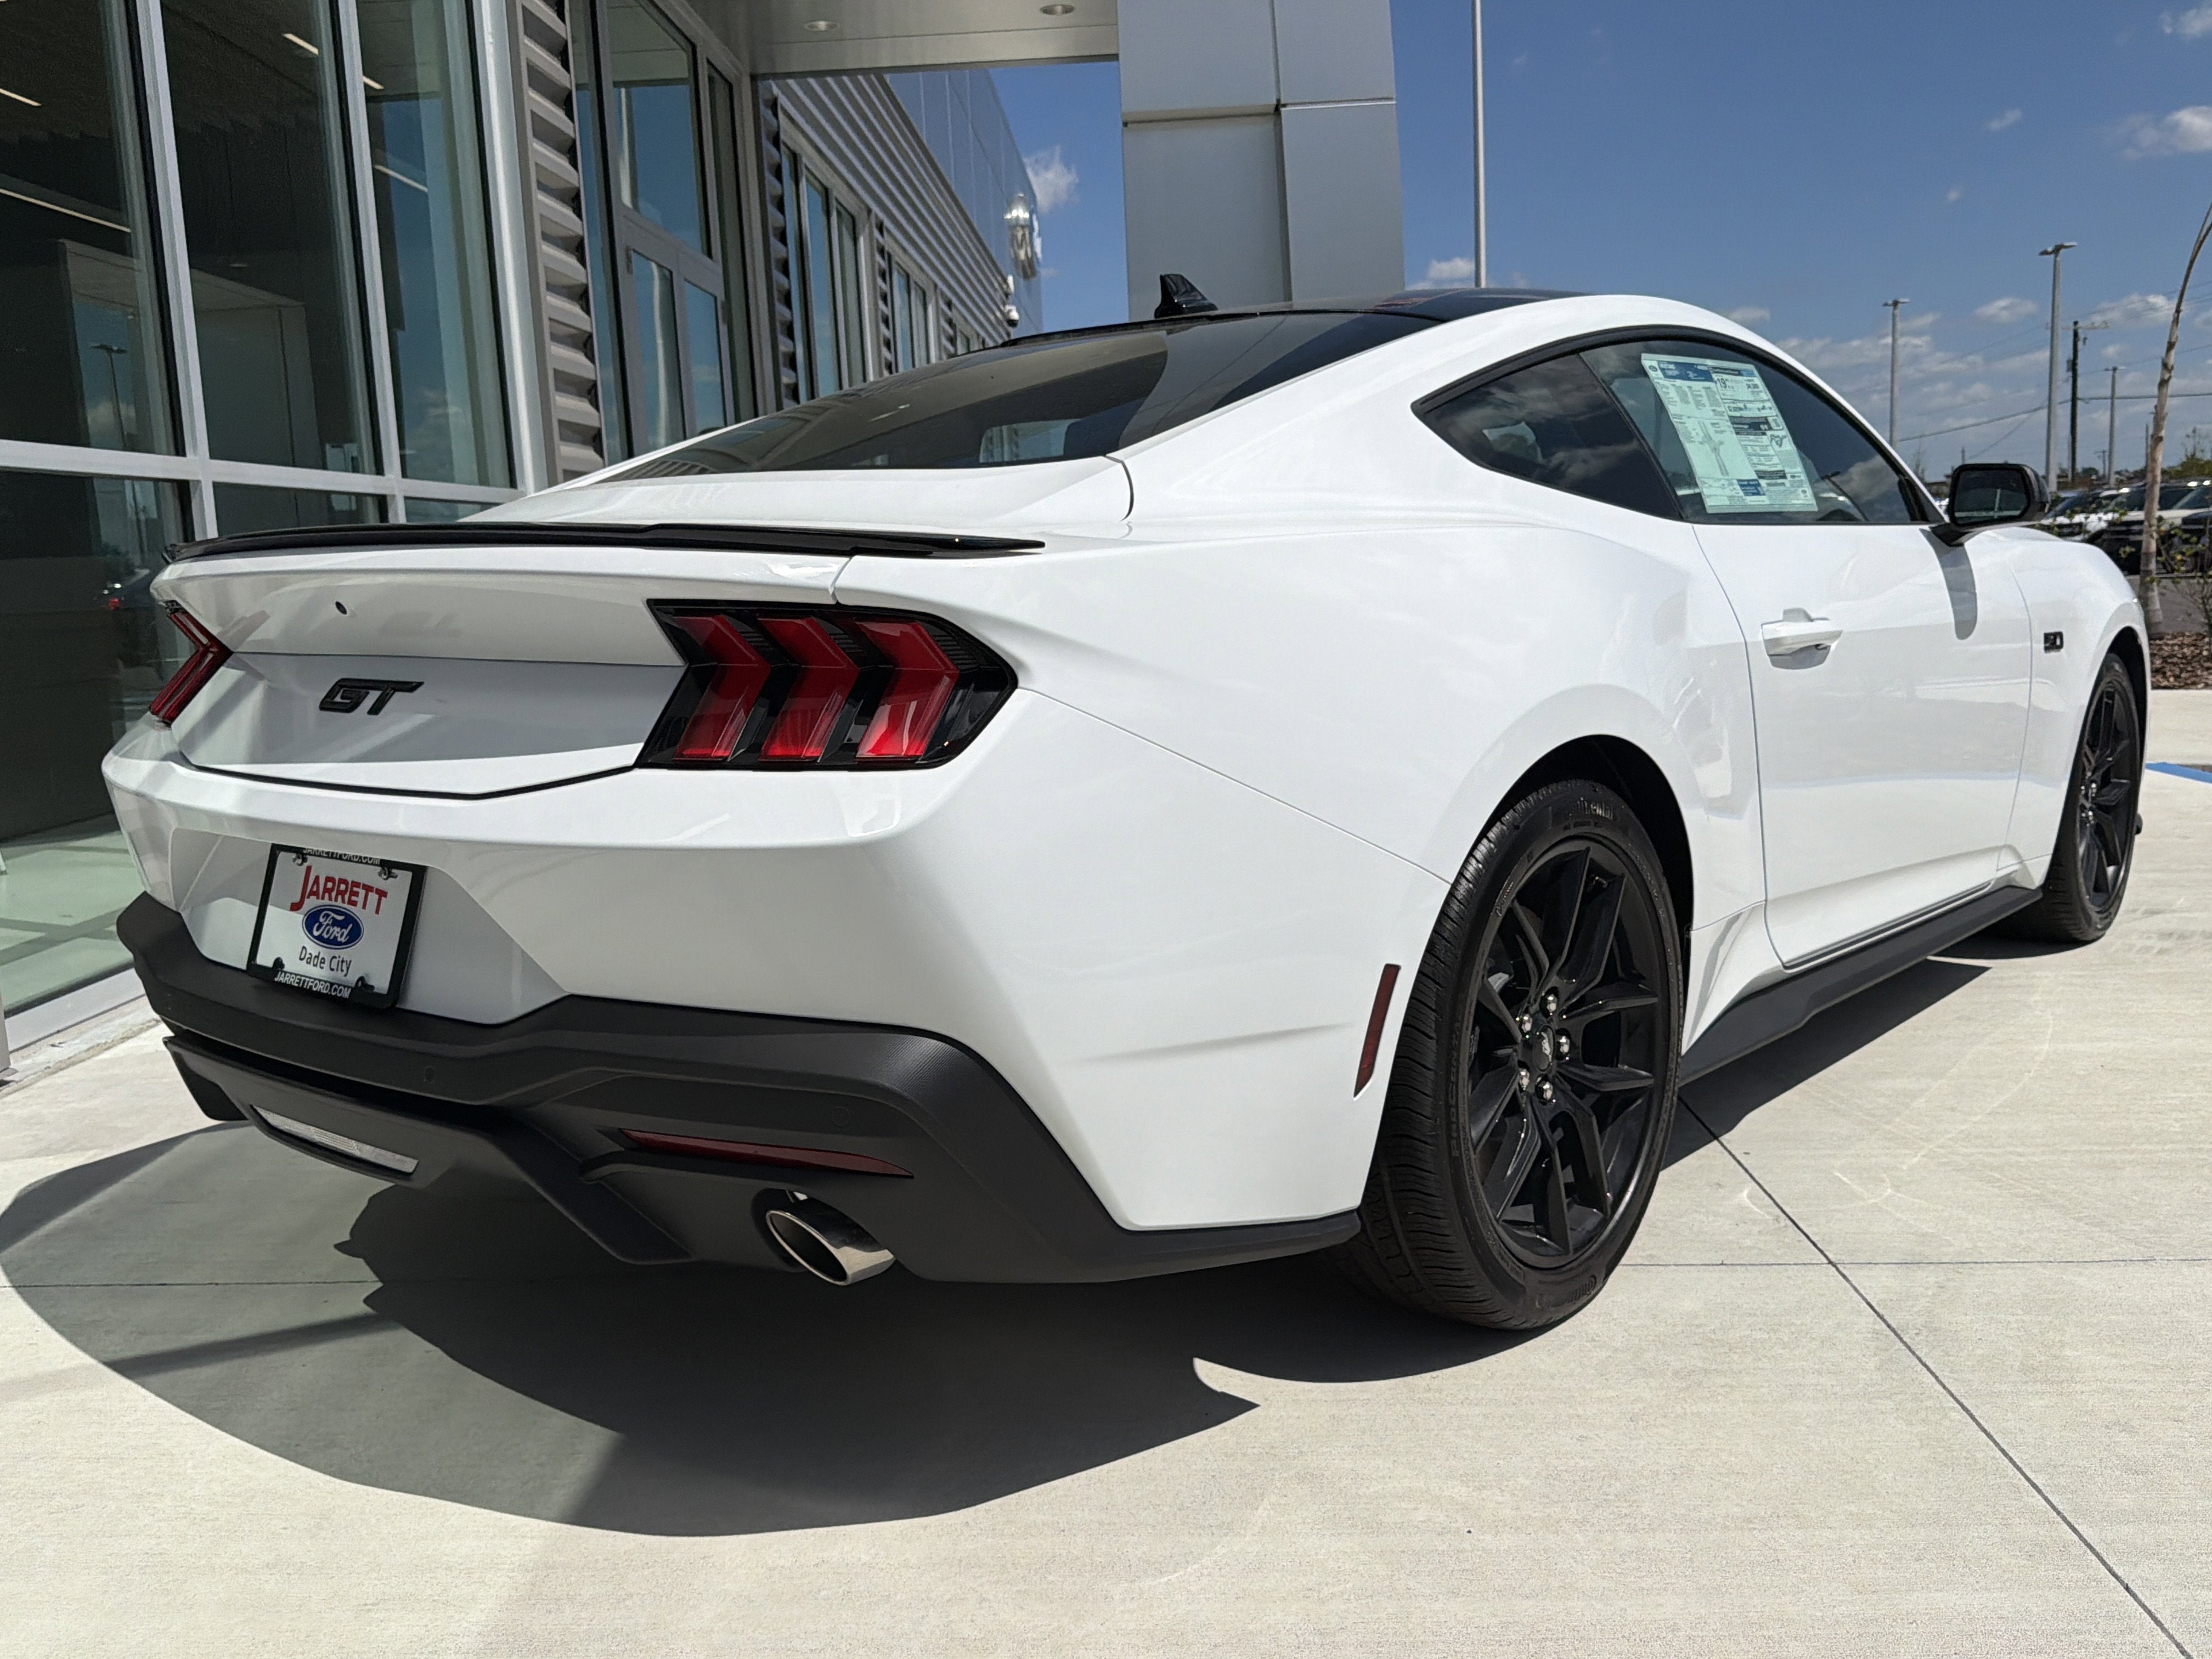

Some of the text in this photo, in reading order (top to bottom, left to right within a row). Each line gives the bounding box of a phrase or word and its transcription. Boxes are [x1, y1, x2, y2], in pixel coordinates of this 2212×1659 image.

[1717, 377, 1727, 389] 19
[319, 678, 425, 715] GT
[290, 865, 388, 915] JARRETT
[313, 910, 353, 943] Ford
[299, 945, 352, 977] Dade City
[274, 971, 352, 999] JARRETTFORD.COM
